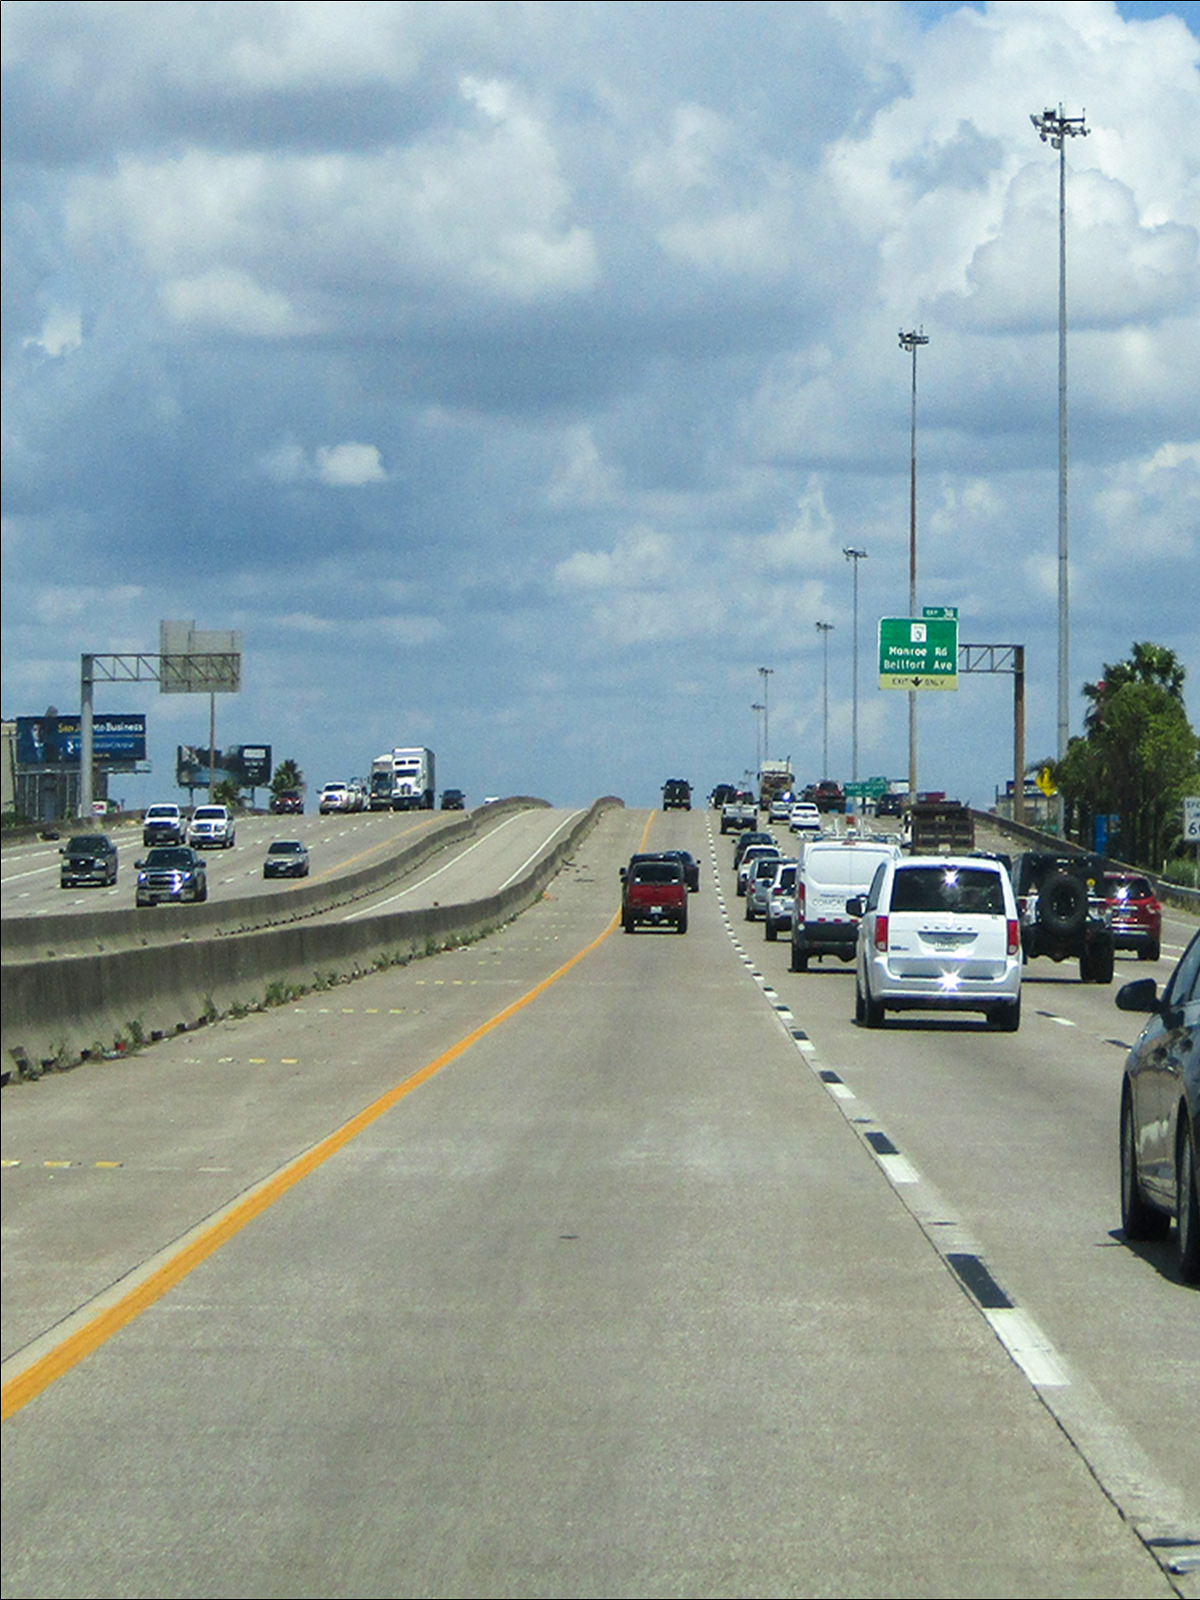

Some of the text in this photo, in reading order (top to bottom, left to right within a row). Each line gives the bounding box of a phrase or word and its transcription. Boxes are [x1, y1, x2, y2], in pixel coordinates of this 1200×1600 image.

[913, 630, 922, 641] 3
[888, 646, 948, 657] Monroe Rd
[884, 660, 953, 670] Bellfort Ave
[892, 677, 945, 686] EXIT ONLY
[106, 722, 143, 732] Business
